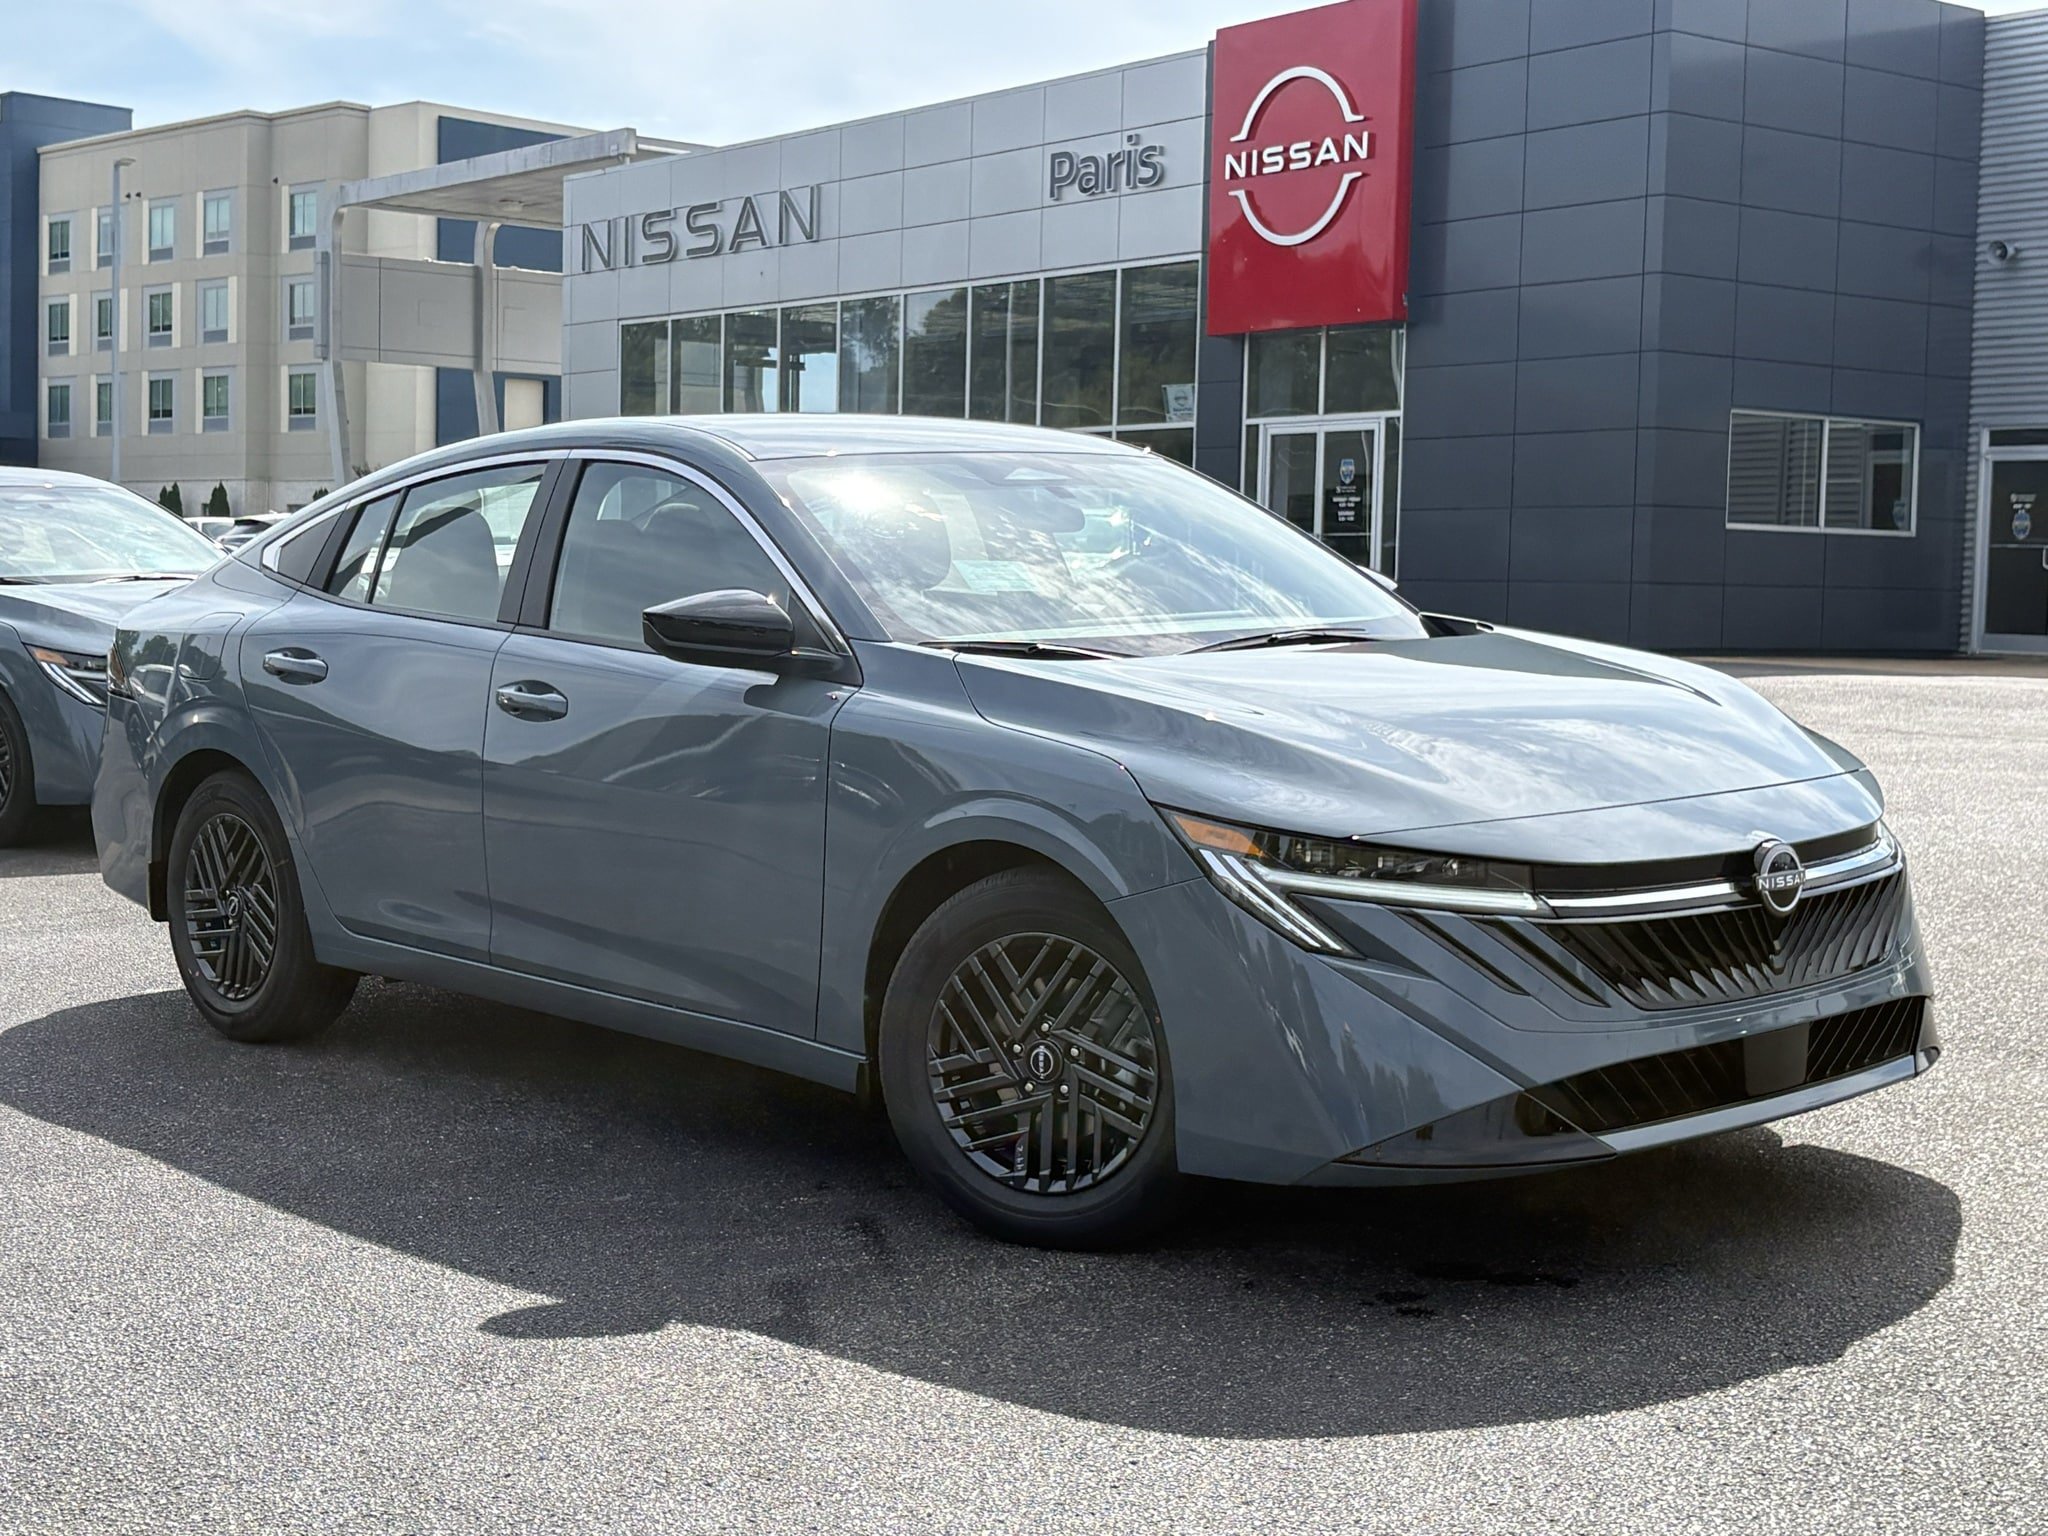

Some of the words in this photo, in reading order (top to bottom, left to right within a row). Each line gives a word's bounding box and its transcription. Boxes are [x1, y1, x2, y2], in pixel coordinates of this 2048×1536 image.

[1049, 134, 1164, 200] Paris
[1225, 131, 1369, 180] NISSAN
[582, 184, 820, 273] NISSAN
[1758, 872, 1806, 890] NISSAN
